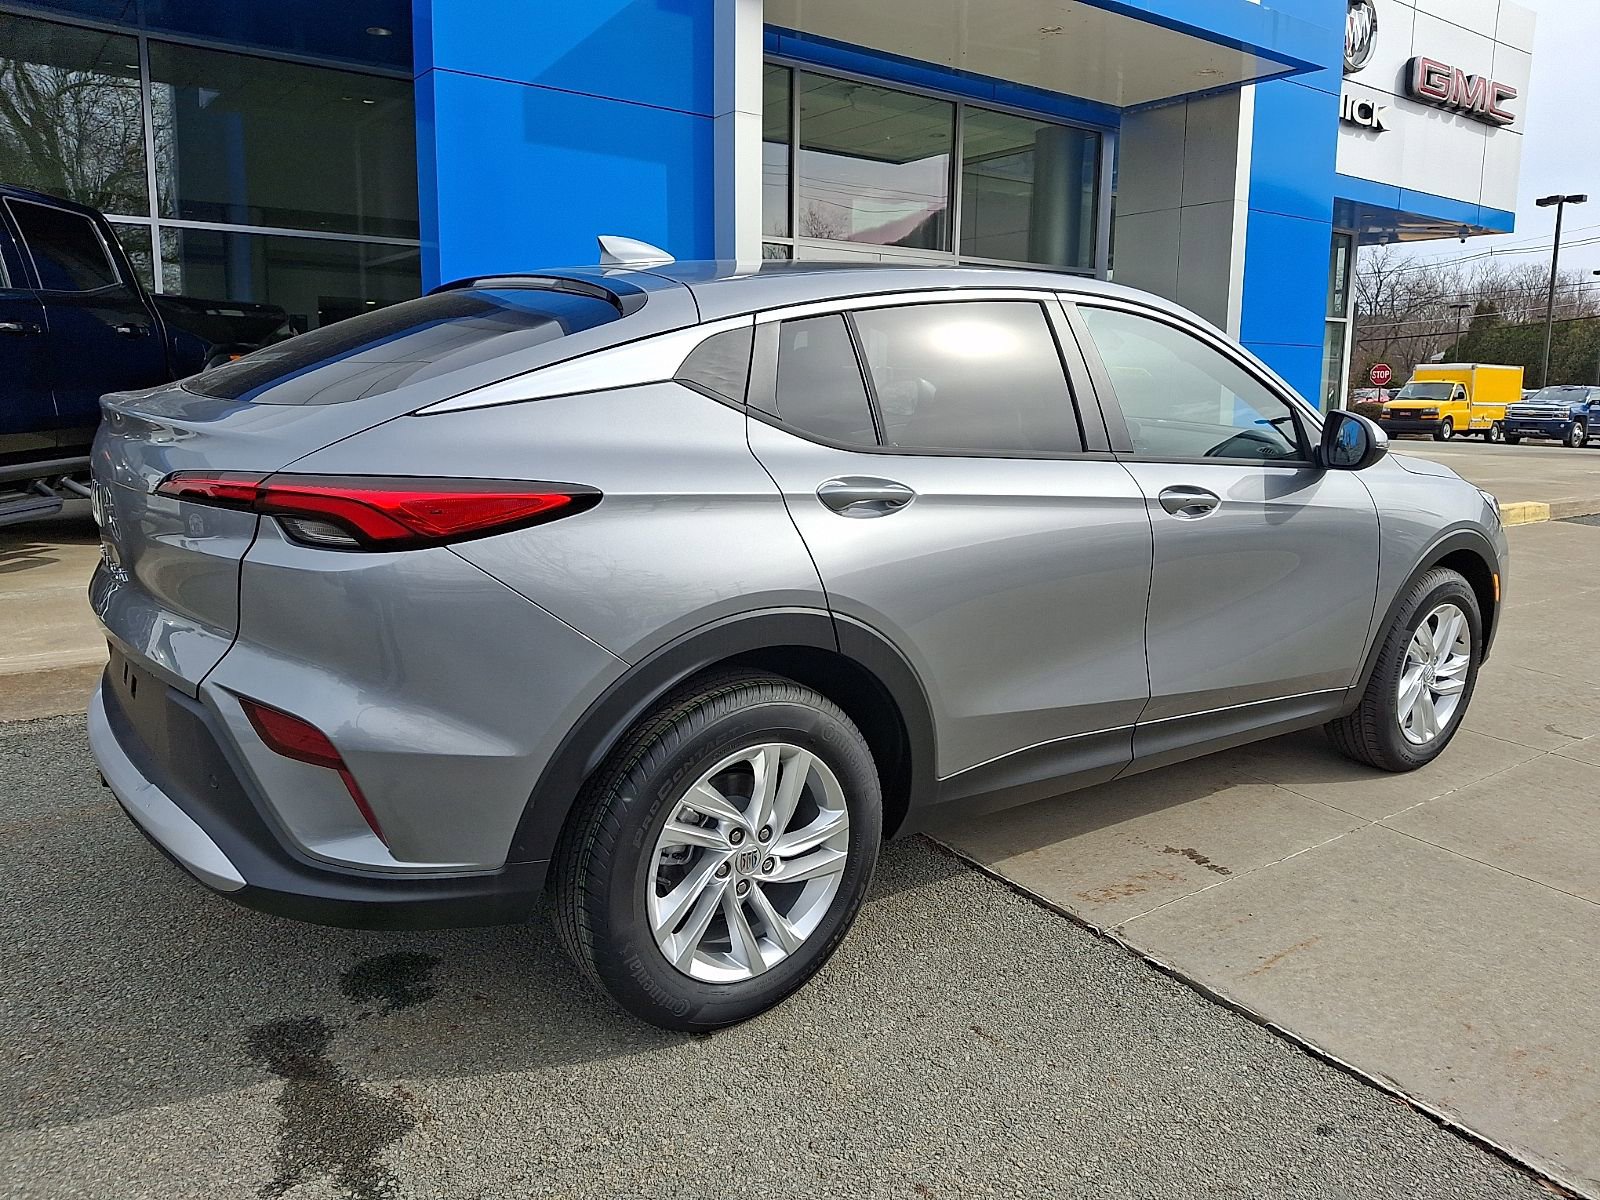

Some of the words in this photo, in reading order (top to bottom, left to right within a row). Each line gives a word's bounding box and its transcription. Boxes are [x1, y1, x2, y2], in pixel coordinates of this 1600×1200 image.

[1413, 56, 1518, 124] GMC
[1371, 370, 1390, 379] STOP
[620, 950, 693, 1020] Continental
